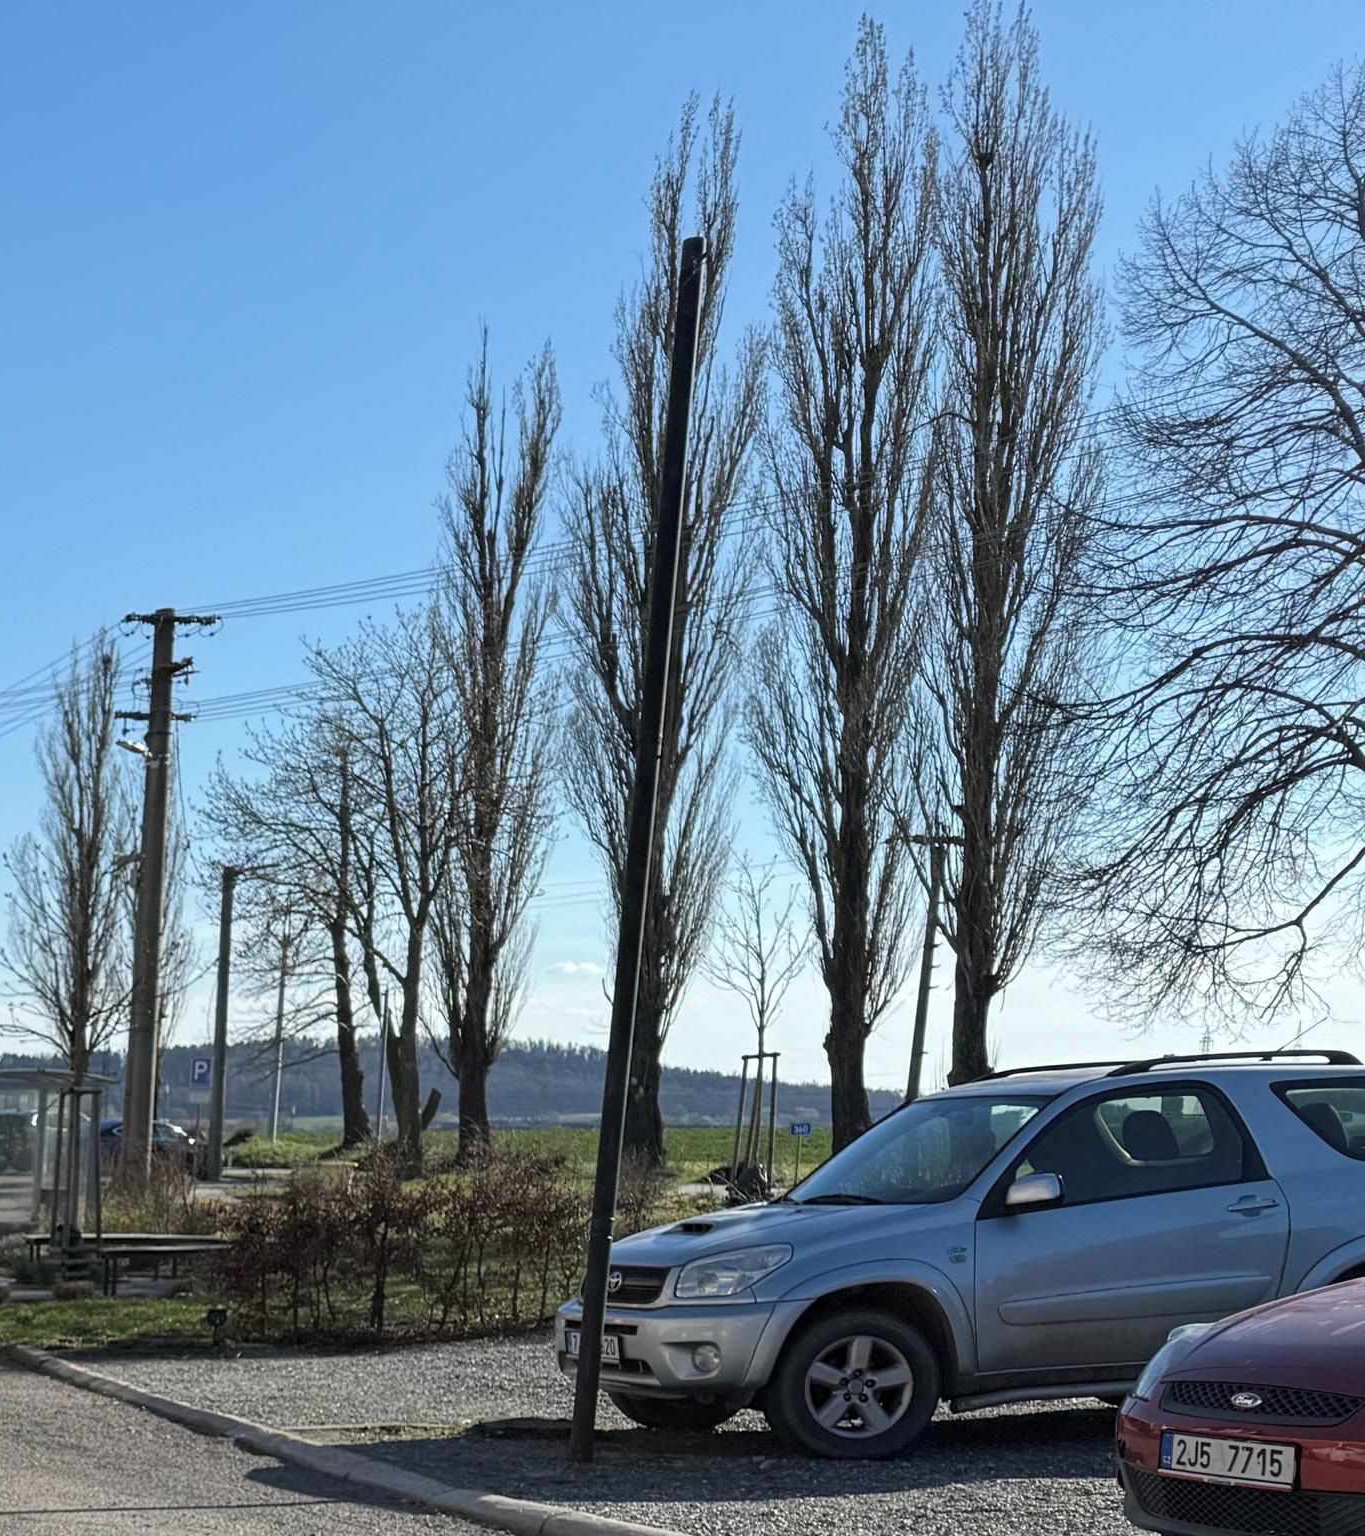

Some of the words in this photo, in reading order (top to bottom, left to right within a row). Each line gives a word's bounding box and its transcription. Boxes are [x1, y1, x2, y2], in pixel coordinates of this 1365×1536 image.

[194, 1060, 208, 1080] P
[1175, 1438, 1212, 1469] 2J5
[1227, 1445, 1284, 1478] 7715
